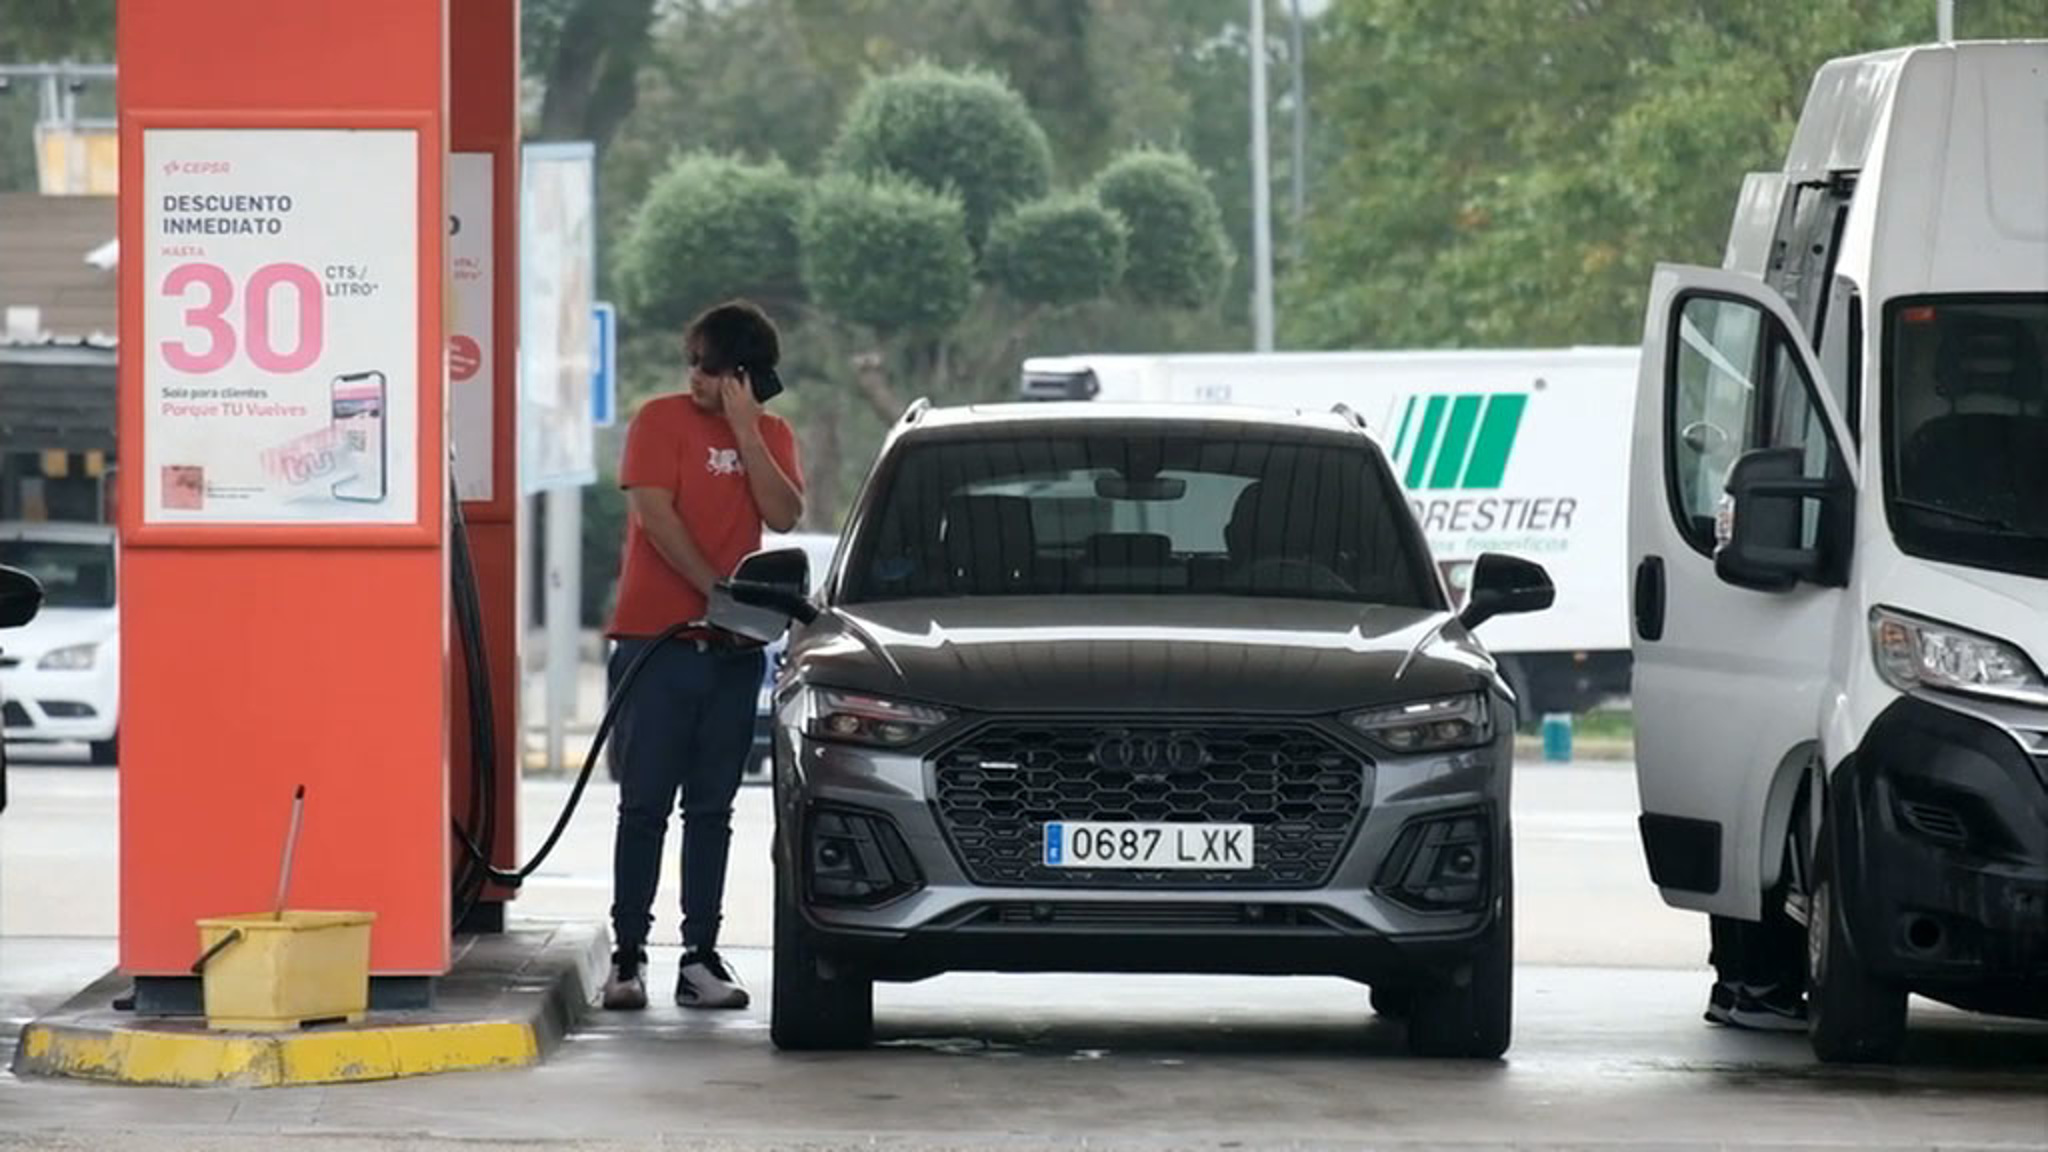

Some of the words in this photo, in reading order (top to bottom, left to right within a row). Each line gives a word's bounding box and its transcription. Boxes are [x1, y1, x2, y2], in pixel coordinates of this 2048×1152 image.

[183, 162, 230, 173] CEPSA
[163, 196, 292, 212] DESCUENTO
[163, 218, 282, 234] INMEDIATO
[162, 246, 204, 255] HASTA
[161, 263, 323, 373] 30
[221, 387, 267, 399] clientes
[162, 403, 217, 419] Porque
[222, 403, 243, 416] TU
[246, 403, 306, 416] Vuelves
[1072, 828, 1162, 861] 0687
[1178, 830, 1243, 861] LXK
